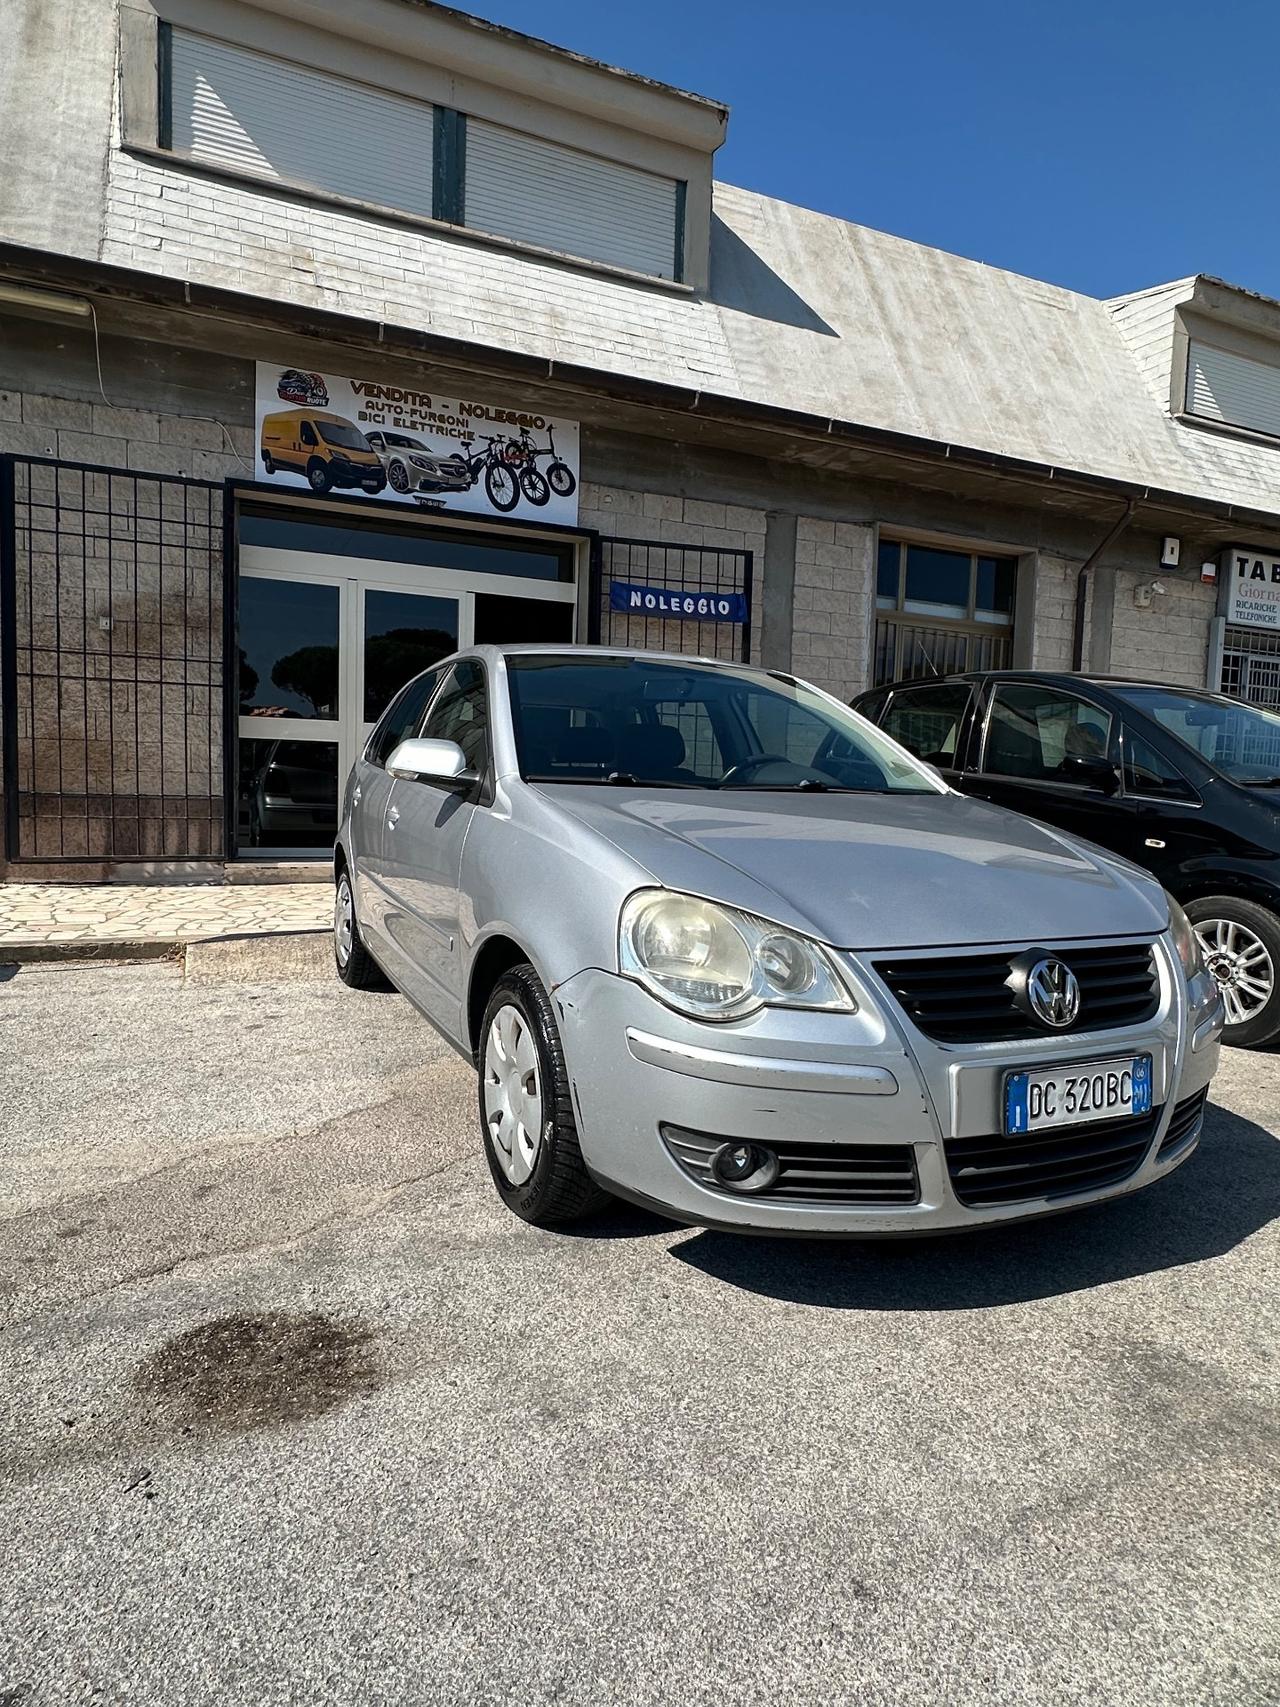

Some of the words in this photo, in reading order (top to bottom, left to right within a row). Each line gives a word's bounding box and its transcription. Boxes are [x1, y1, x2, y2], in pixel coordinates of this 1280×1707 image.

[350, 380, 432, 409] VENDITA
[459, 402, 546, 430] NOLEGGIO
[365, 400, 469, 429] AUTO-FURGONI
[357, 410, 386, 425] BICI
[393, 416, 476, 441] ELETTRICHE
[630, 590, 730, 616] NOLEGGIO
[1235, 599, 1278, 614] RICARICHE
[1235, 610, 1278, 624] TELEFONICHE
[1029, 1081, 1057, 1120] DC
[1064, 1069, 1133, 1114] 320BC
